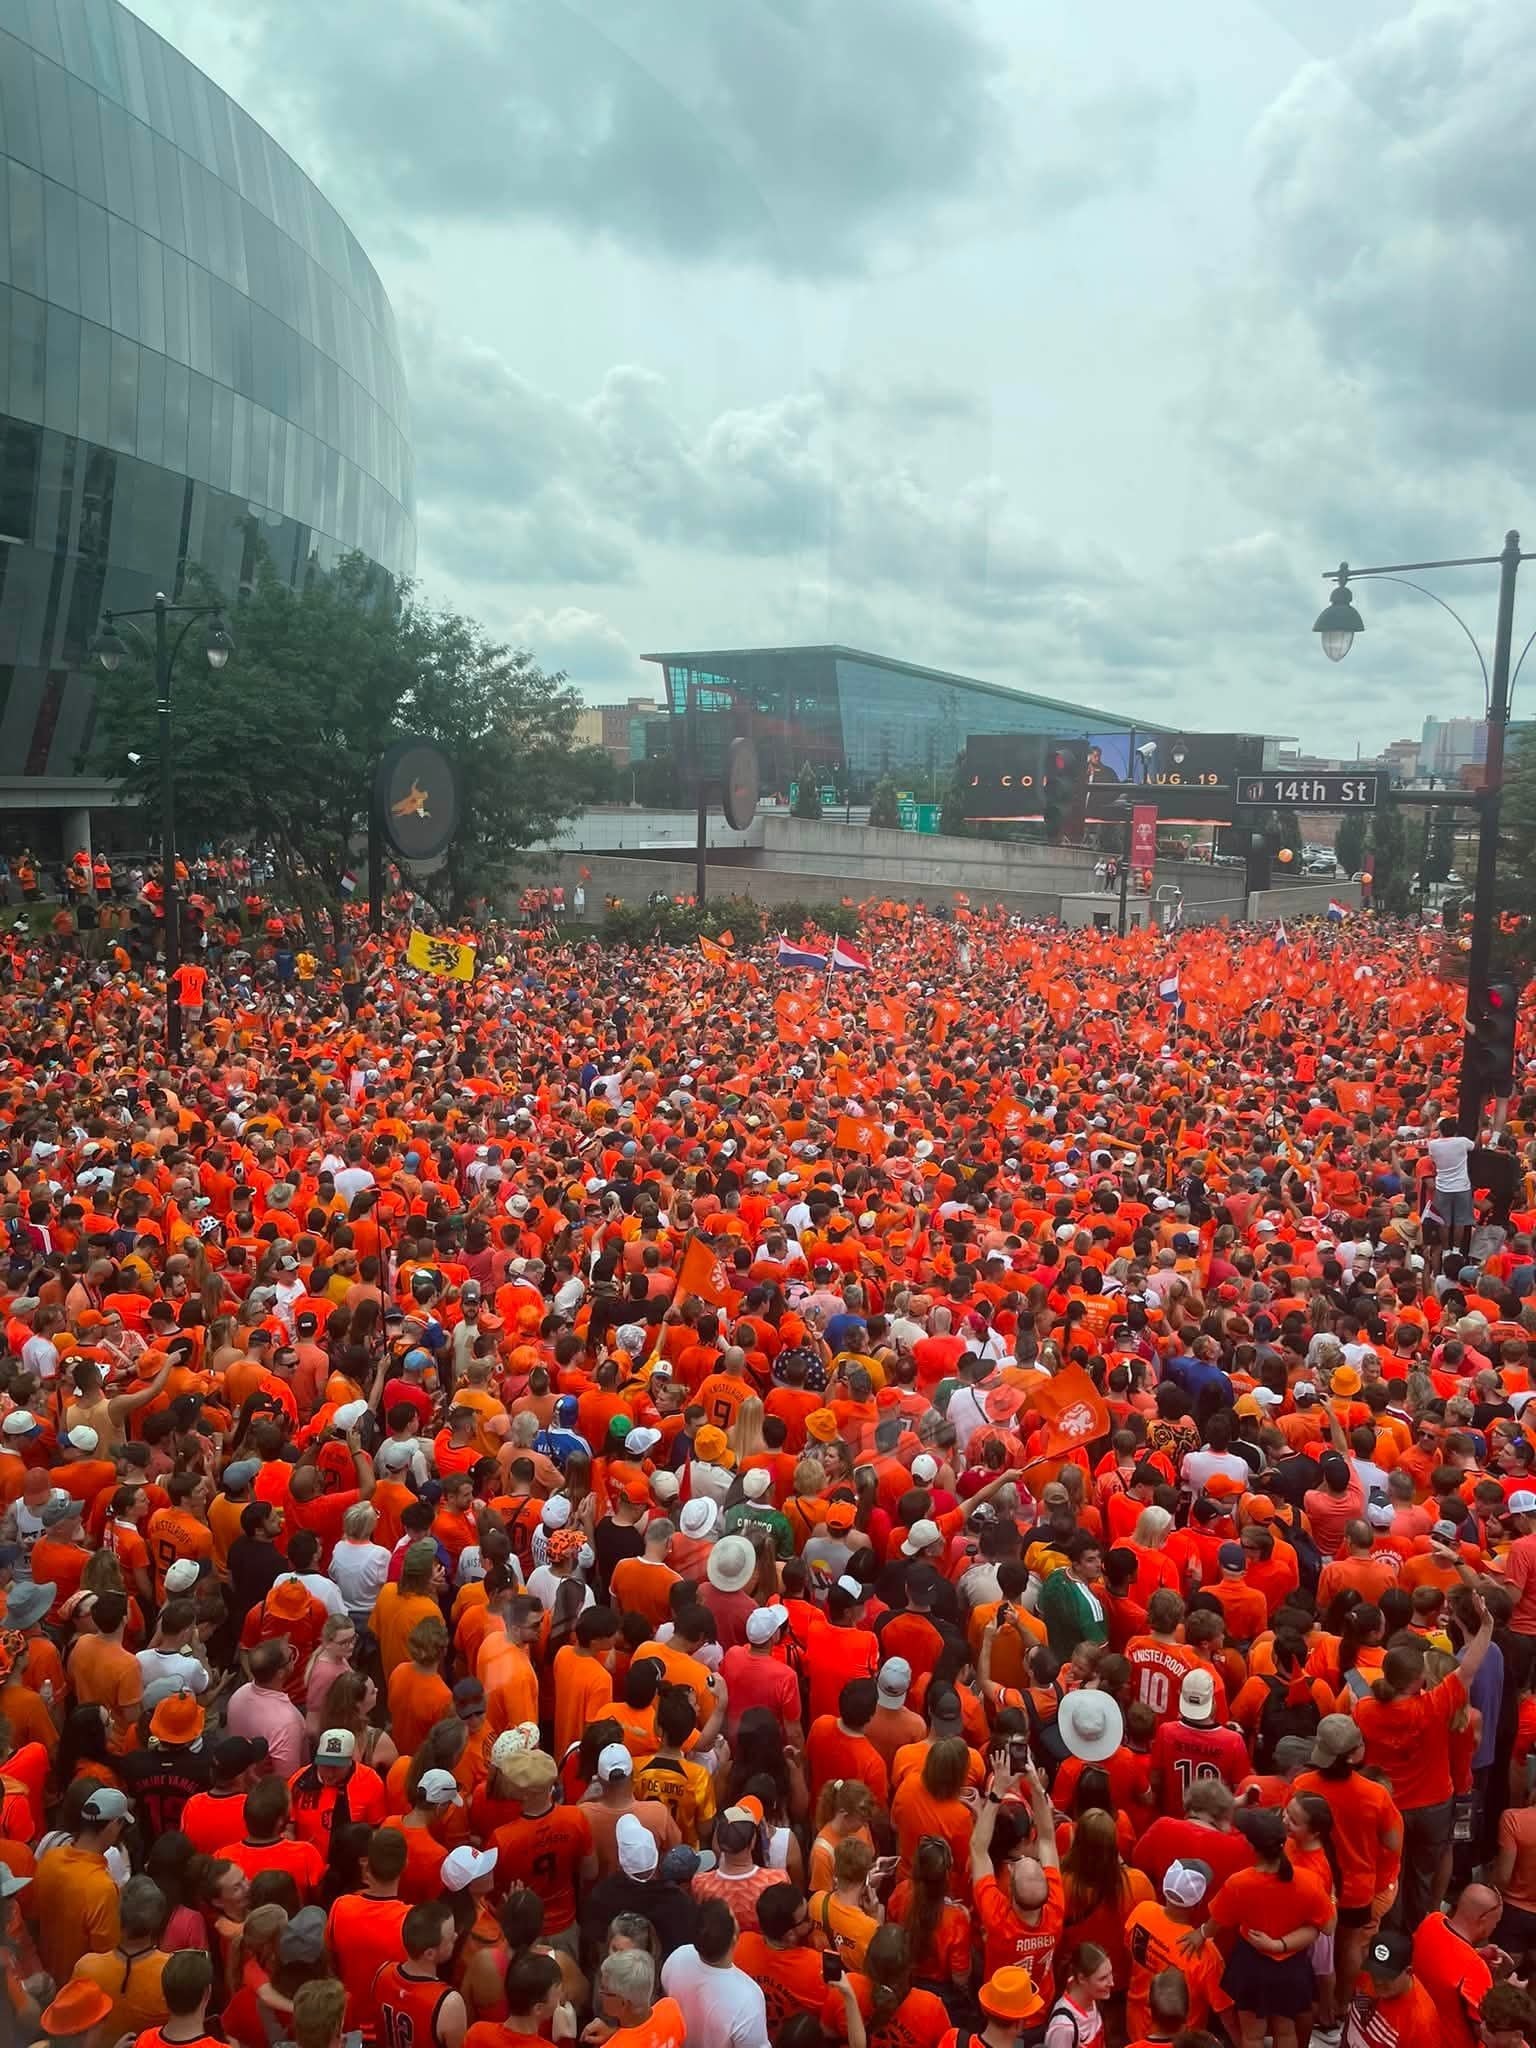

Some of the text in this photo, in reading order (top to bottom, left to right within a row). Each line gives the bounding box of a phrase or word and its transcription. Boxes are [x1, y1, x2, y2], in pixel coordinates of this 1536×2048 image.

[1199, 773, 1218, 786] 19
[1274, 780, 1367, 801] 14th St
[158, 1539, 177, 1577] 9
[1139, 1667, 1169, 1714] 10
[1015, 1934, 1056, 1952] ROBBEN
